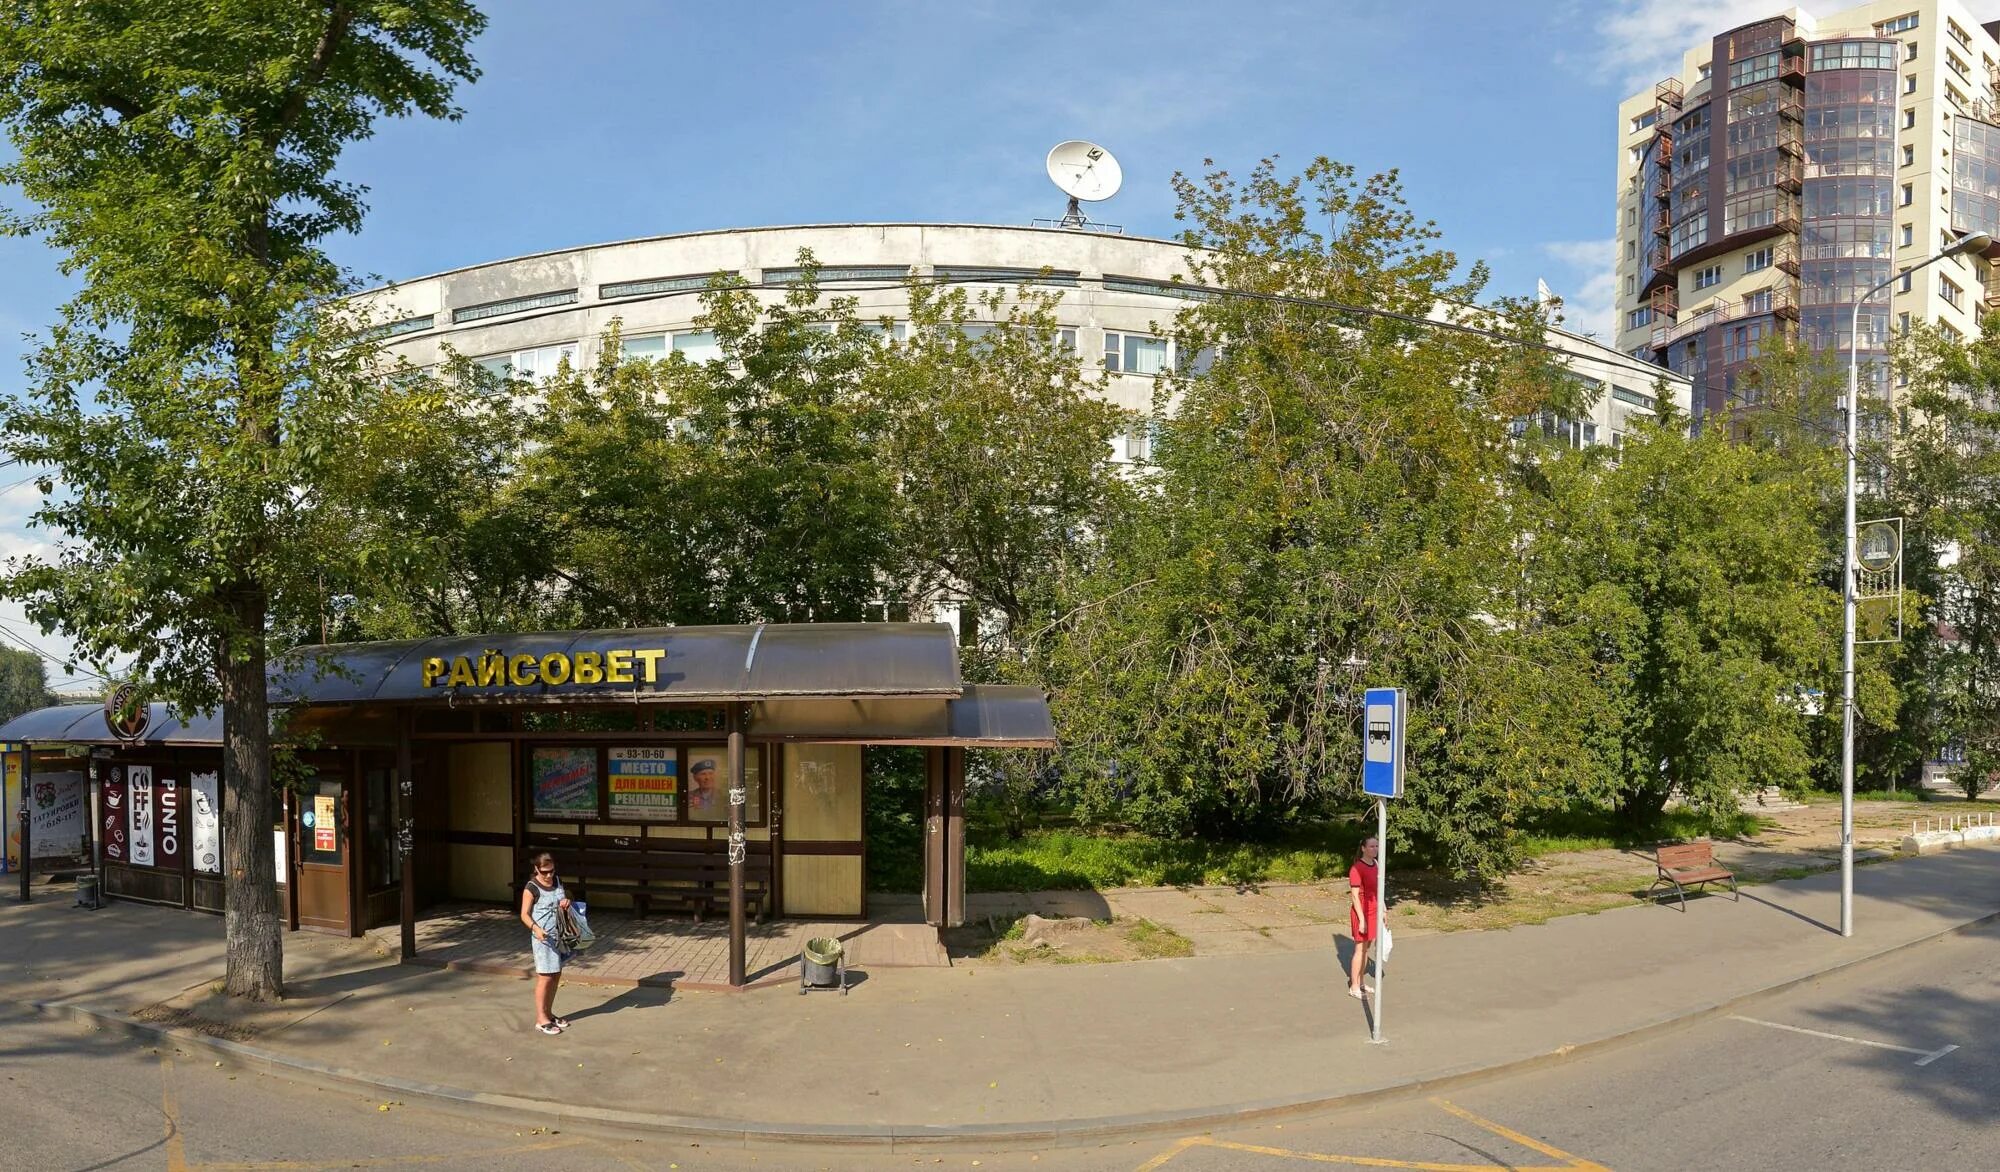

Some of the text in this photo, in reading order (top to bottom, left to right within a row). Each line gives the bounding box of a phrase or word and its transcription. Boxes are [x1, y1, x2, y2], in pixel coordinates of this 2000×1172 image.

[421, 649, 665, 688] РАЙСОВЕТ
[627, 750, 665, 759] 93-10-60
[620, 762, 666, 774] МЕСТО
[615, 777, 673, 790] ДЛЯ ВАШЕЙ
[615, 793, 673, 806] РЕКЛАМЫ
[33, 799, 79, 824] ТАТУИРОВКИ
[161, 779, 177, 855] PUNTO
